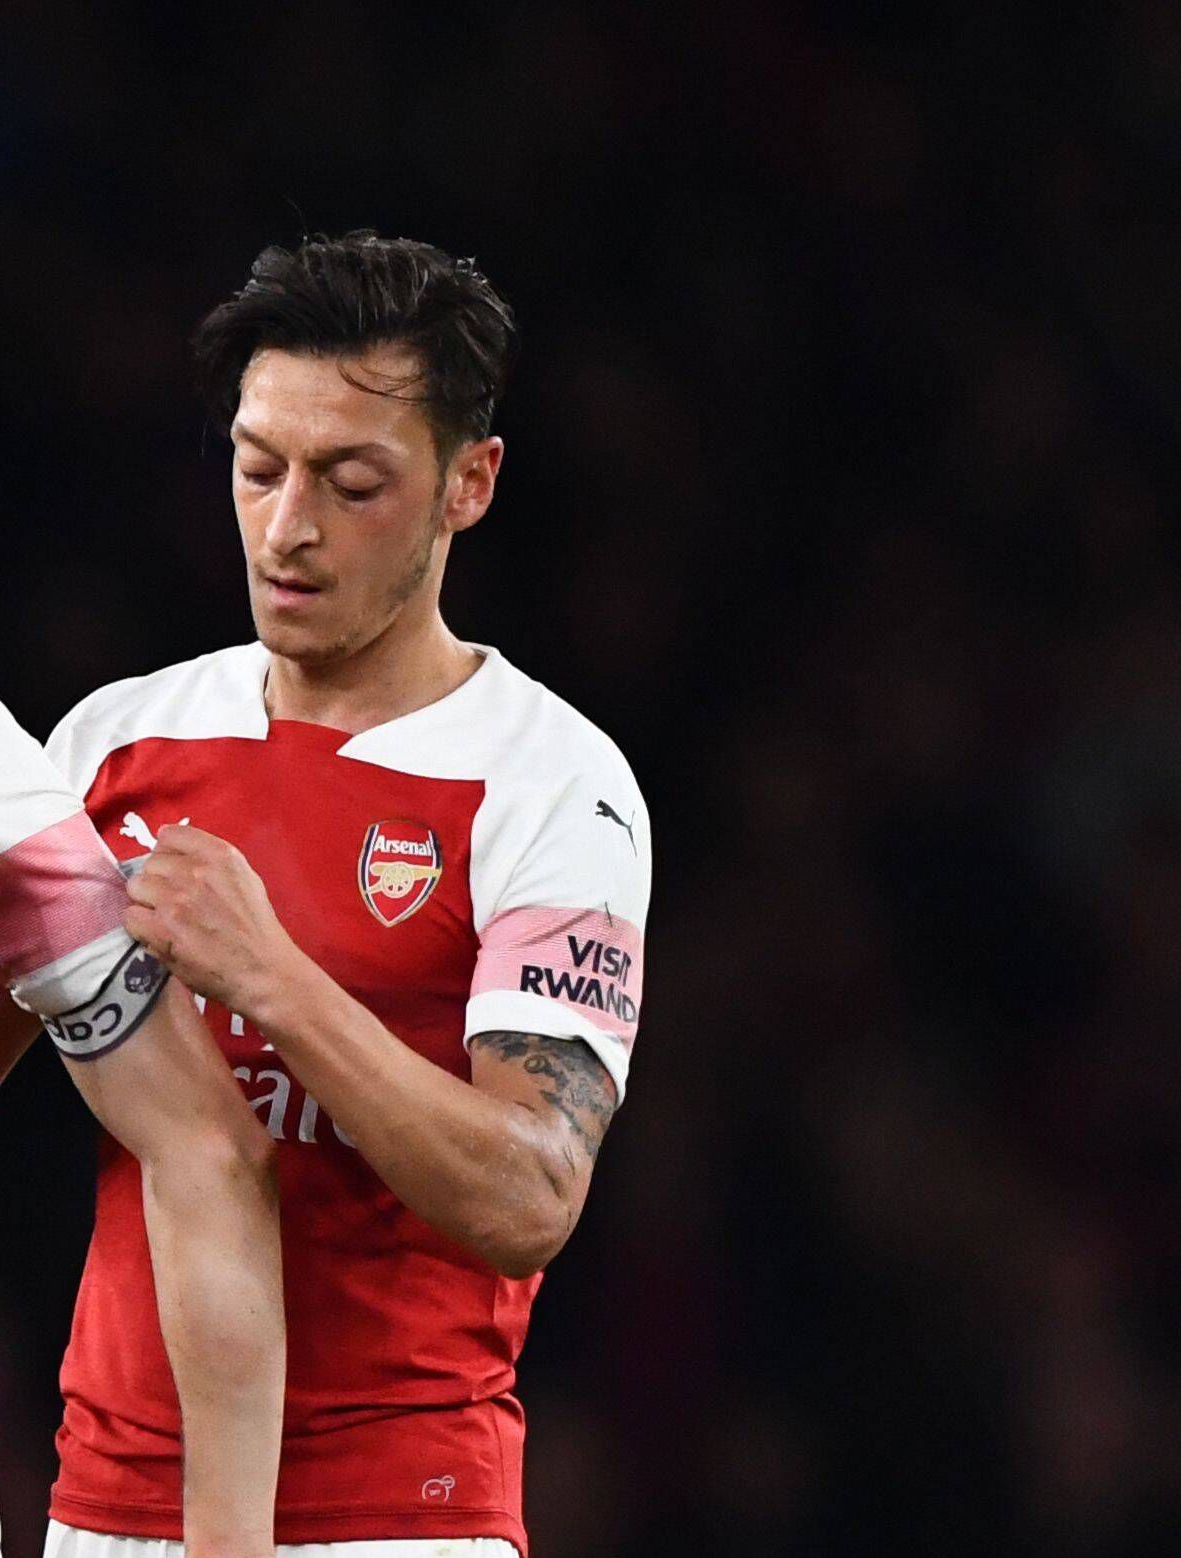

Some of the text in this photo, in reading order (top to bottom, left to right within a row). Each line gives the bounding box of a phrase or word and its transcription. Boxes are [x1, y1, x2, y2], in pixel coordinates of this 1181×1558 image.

[373, 835, 432, 857] Arsenal
[567, 934, 632, 987] VISIT
[519, 964, 636, 1023] RWAND
